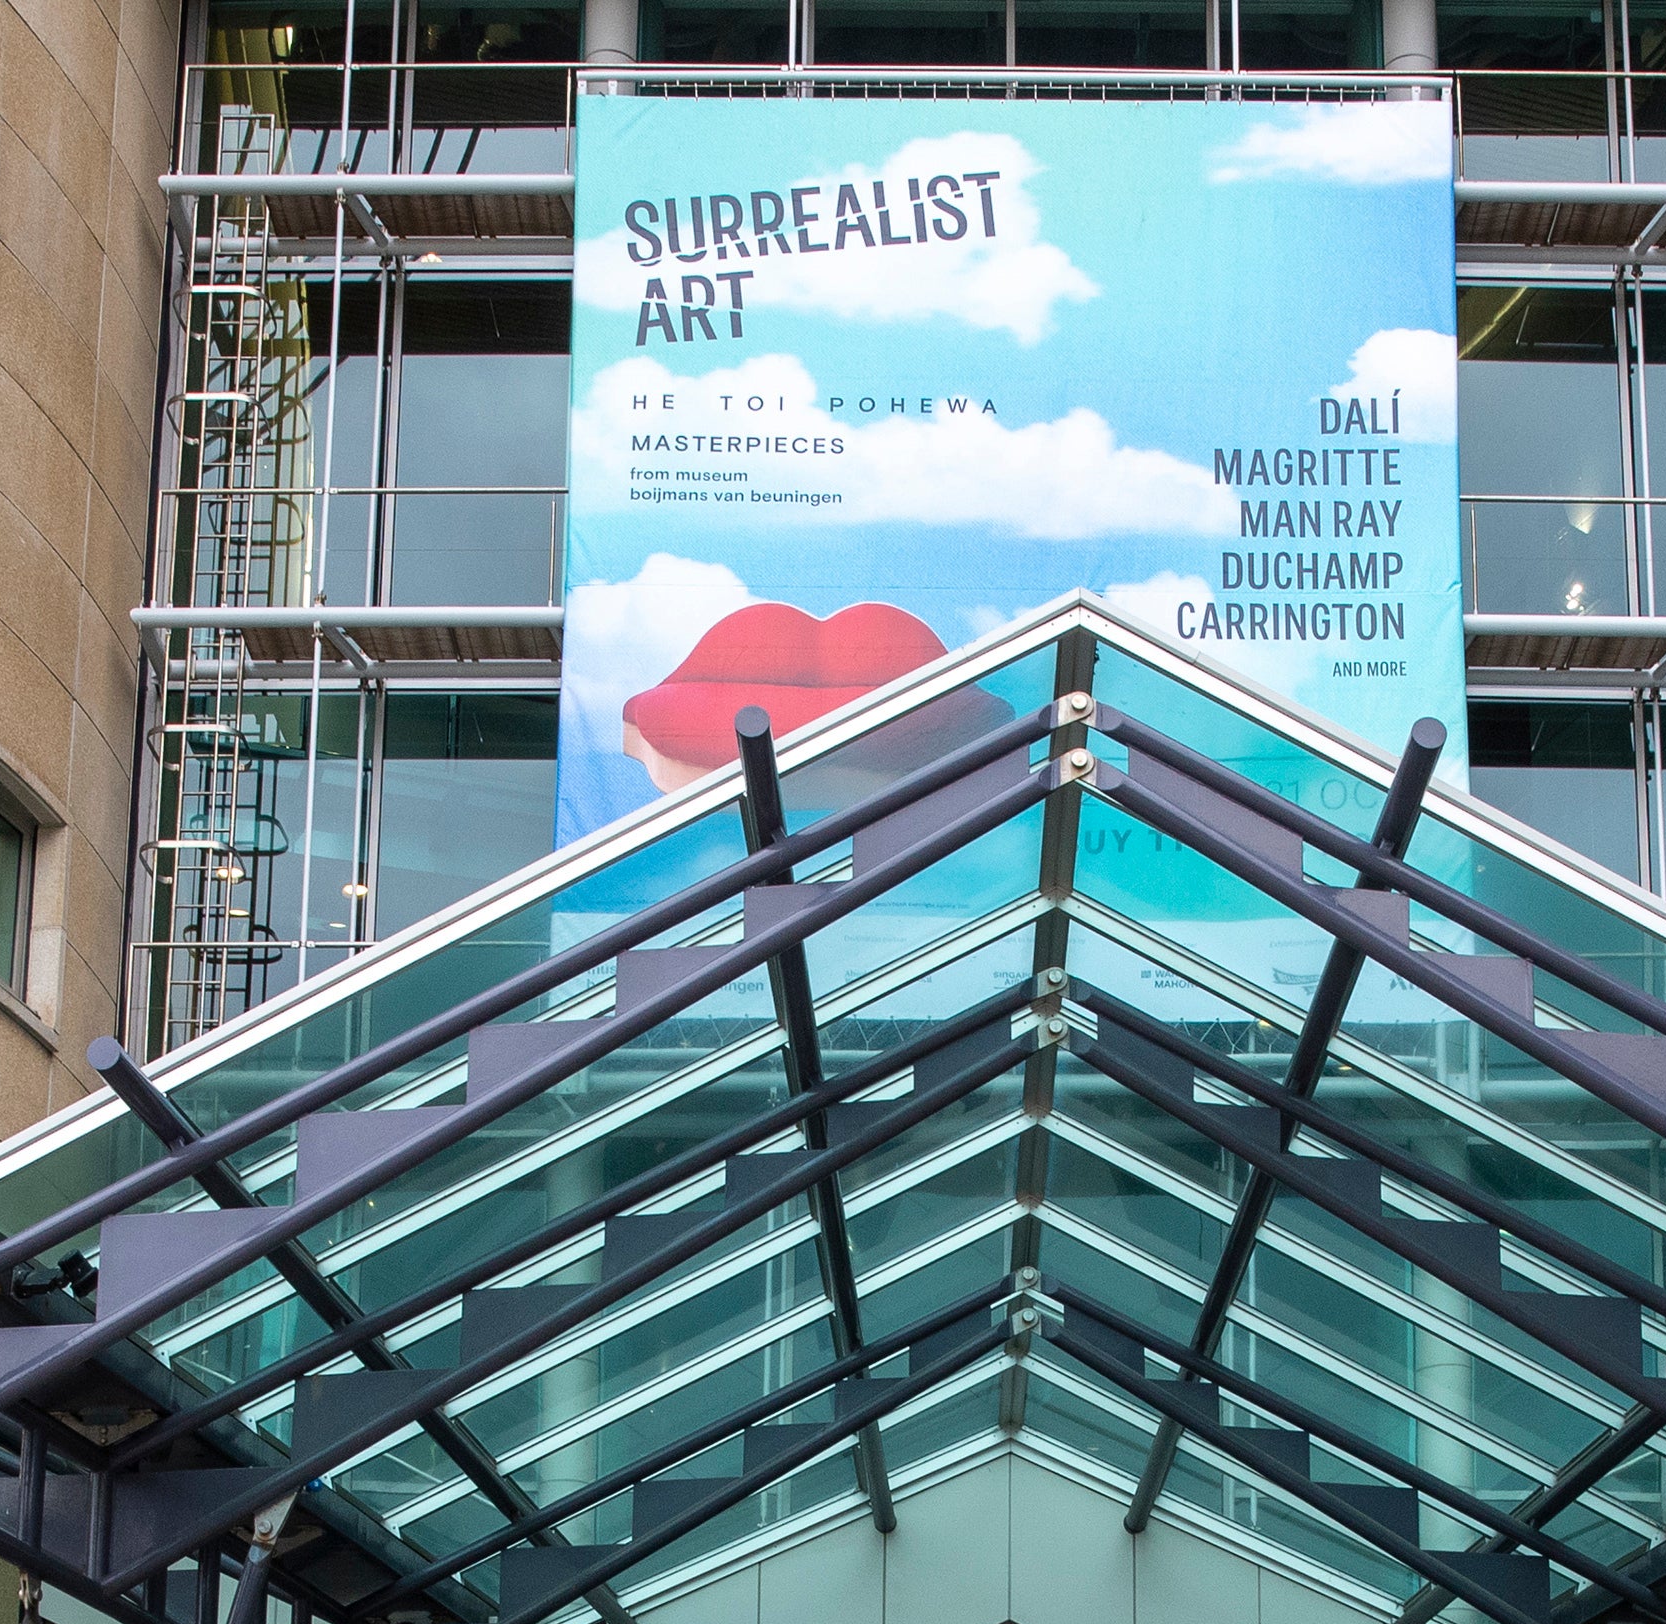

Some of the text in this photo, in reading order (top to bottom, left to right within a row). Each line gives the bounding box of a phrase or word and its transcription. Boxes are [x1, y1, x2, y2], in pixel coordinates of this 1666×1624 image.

[624, 171, 1001, 267] SURREALIST
[635, 270, 754, 346] ART
[632, 394, 998, 414] HE TOI POHEWA
[1319, 388, 1401, 435] DALÍ
[631, 434, 845, 454] MASTERPIECES
[629, 466, 749, 482] from museum
[1213, 448, 1402, 486] MAGRITTE
[629, 486, 843, 507] boijmans van beuningen
[1239, 499, 1403, 538] MAN RAY
[1221, 551, 1404, 590] DUCHAMP
[1176, 601, 1405, 641] CARRINGTON
[1332, 661, 1408, 677] AND MORE
[1319, 778, 1379, 811] OC
[1080, 828, 1132, 854] UY
